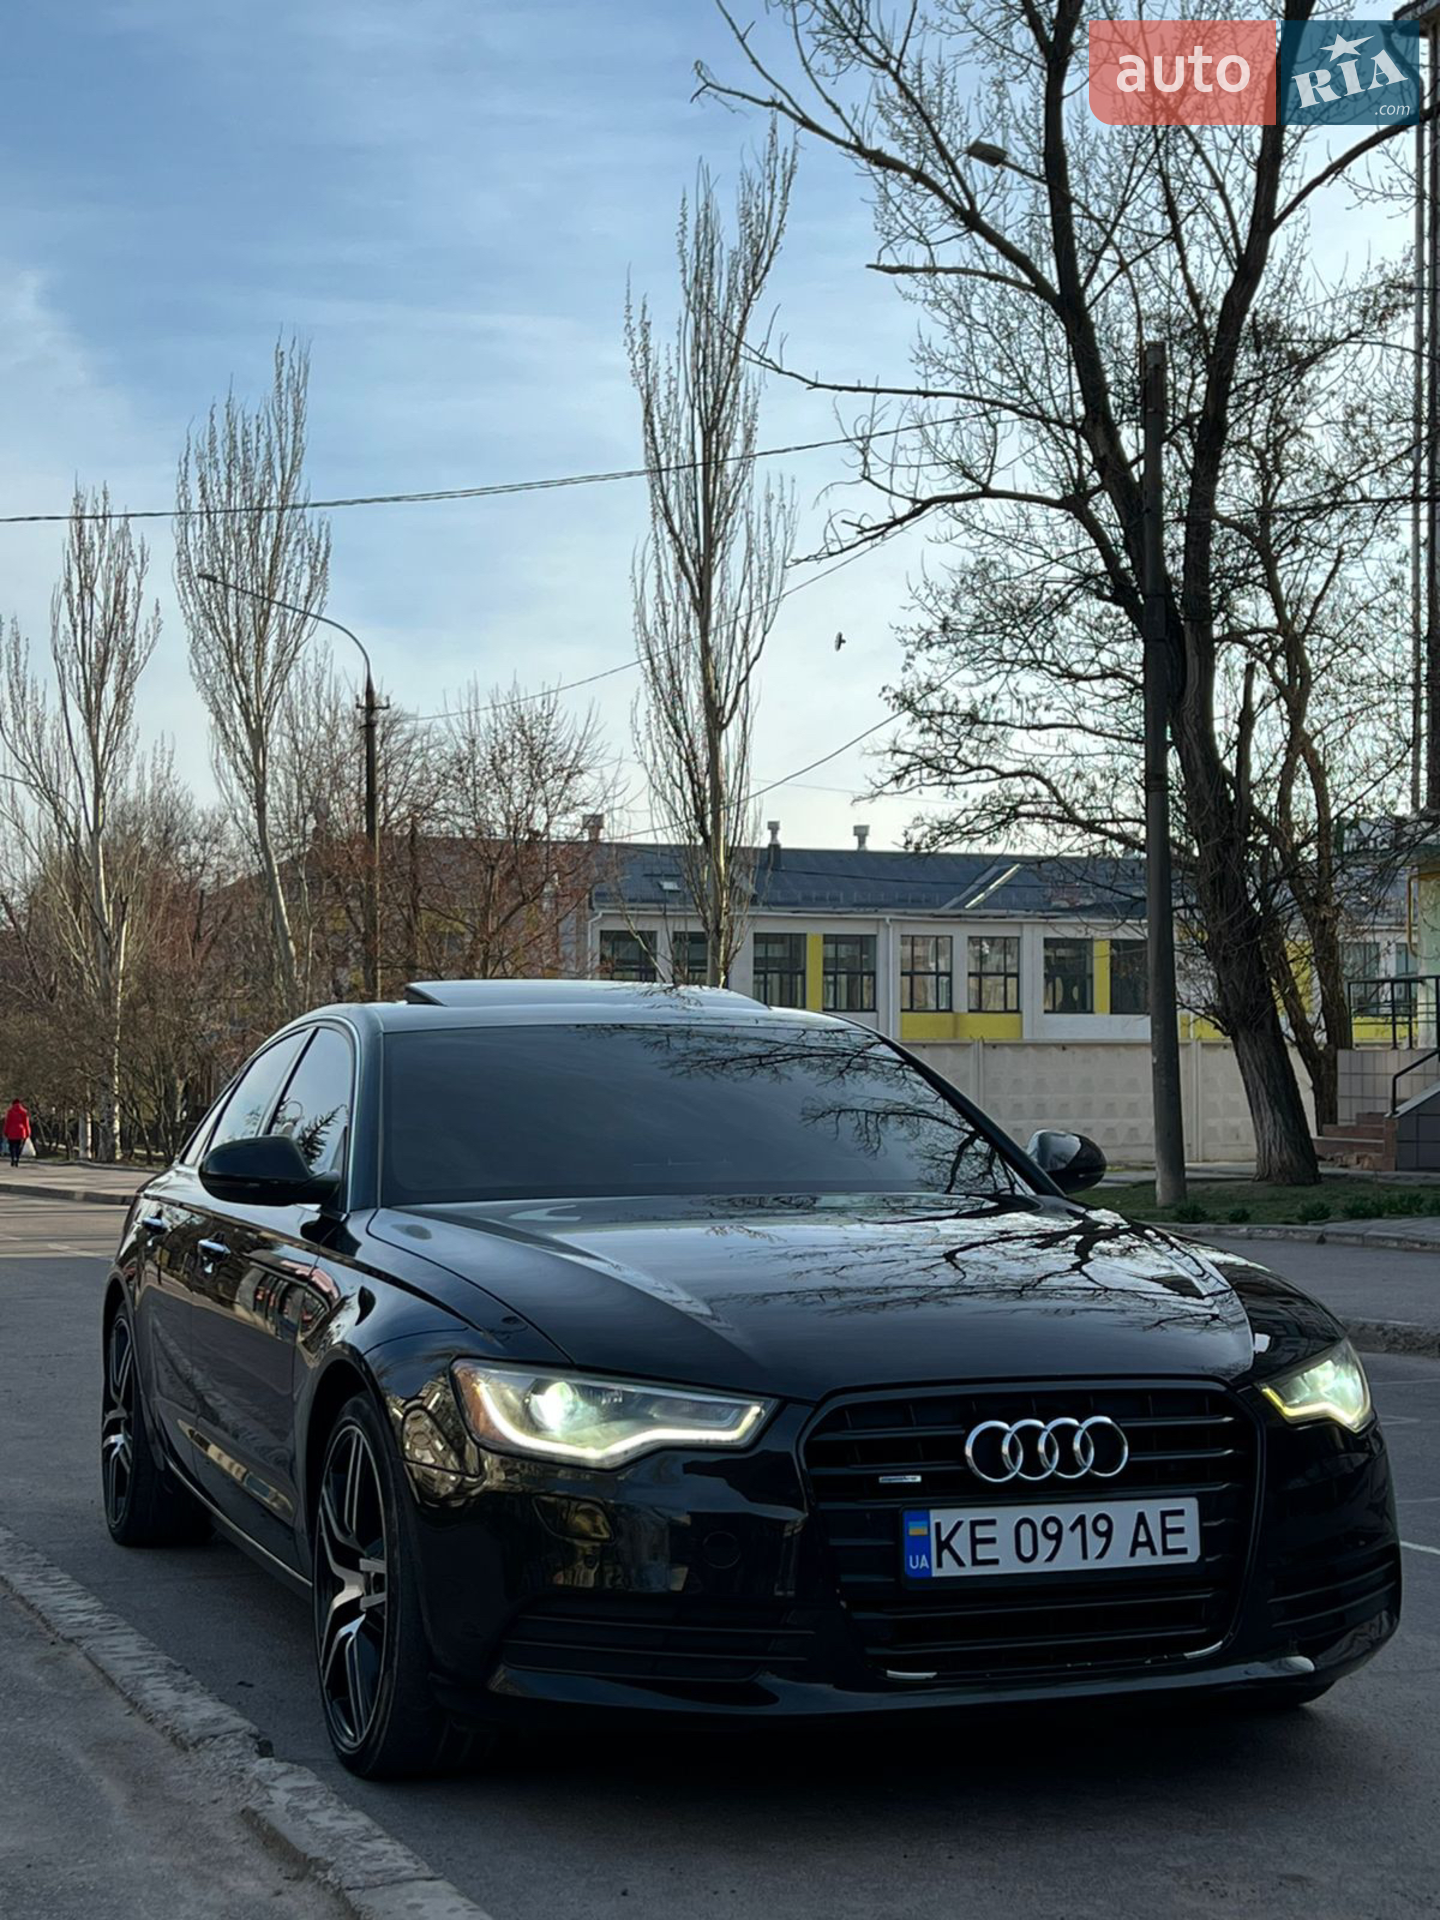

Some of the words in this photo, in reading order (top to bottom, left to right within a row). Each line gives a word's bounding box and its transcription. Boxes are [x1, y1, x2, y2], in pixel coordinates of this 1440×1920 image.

[934, 1518, 1000, 1569] KE
[1014, 1511, 1114, 1563] 0919
[1128, 1508, 1188, 1558] AE
[908, 1554, 930, 1570] UA
